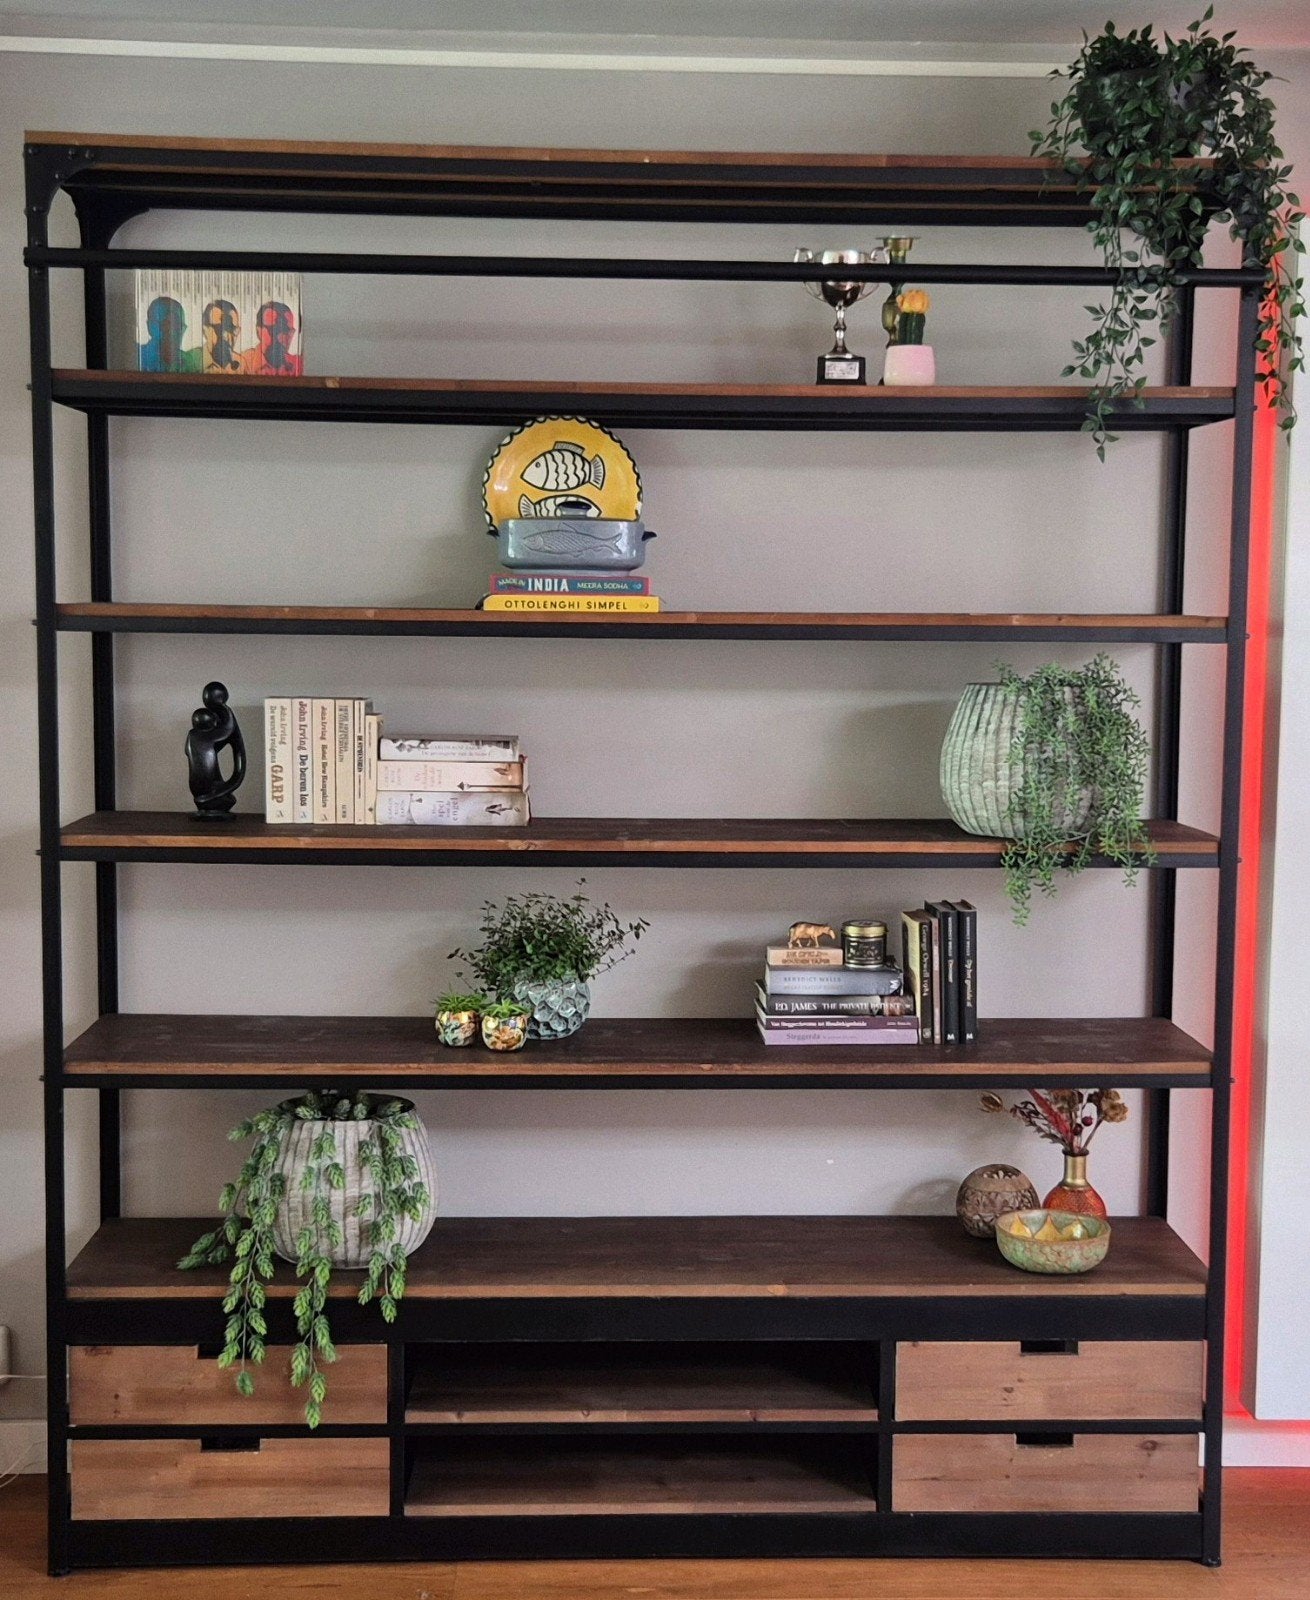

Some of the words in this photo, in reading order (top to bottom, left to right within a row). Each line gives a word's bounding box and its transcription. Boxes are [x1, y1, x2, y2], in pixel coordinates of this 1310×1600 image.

[527, 578, 570, 592] INDIA
[576, 582, 602, 590] MEERA
[603, 582, 629, 590] SODHA
[504, 600, 580, 609] OTTOLENGHI
[586, 601, 628, 610] SIMPEL
[299, 701, 308, 722] John
[297, 724, 308, 751] Irving
[299, 754, 308, 766] De
[271, 764, 284, 804] GARP
[300, 767, 308, 792] beren
[300, 794, 309, 807] los
[922, 952, 930, 978] Orwell
[790, 1002, 818, 1013] JAMES
[838, 1002, 869, 1010] PRIVATE
[786, 1033, 821, 1041] Steggerda
